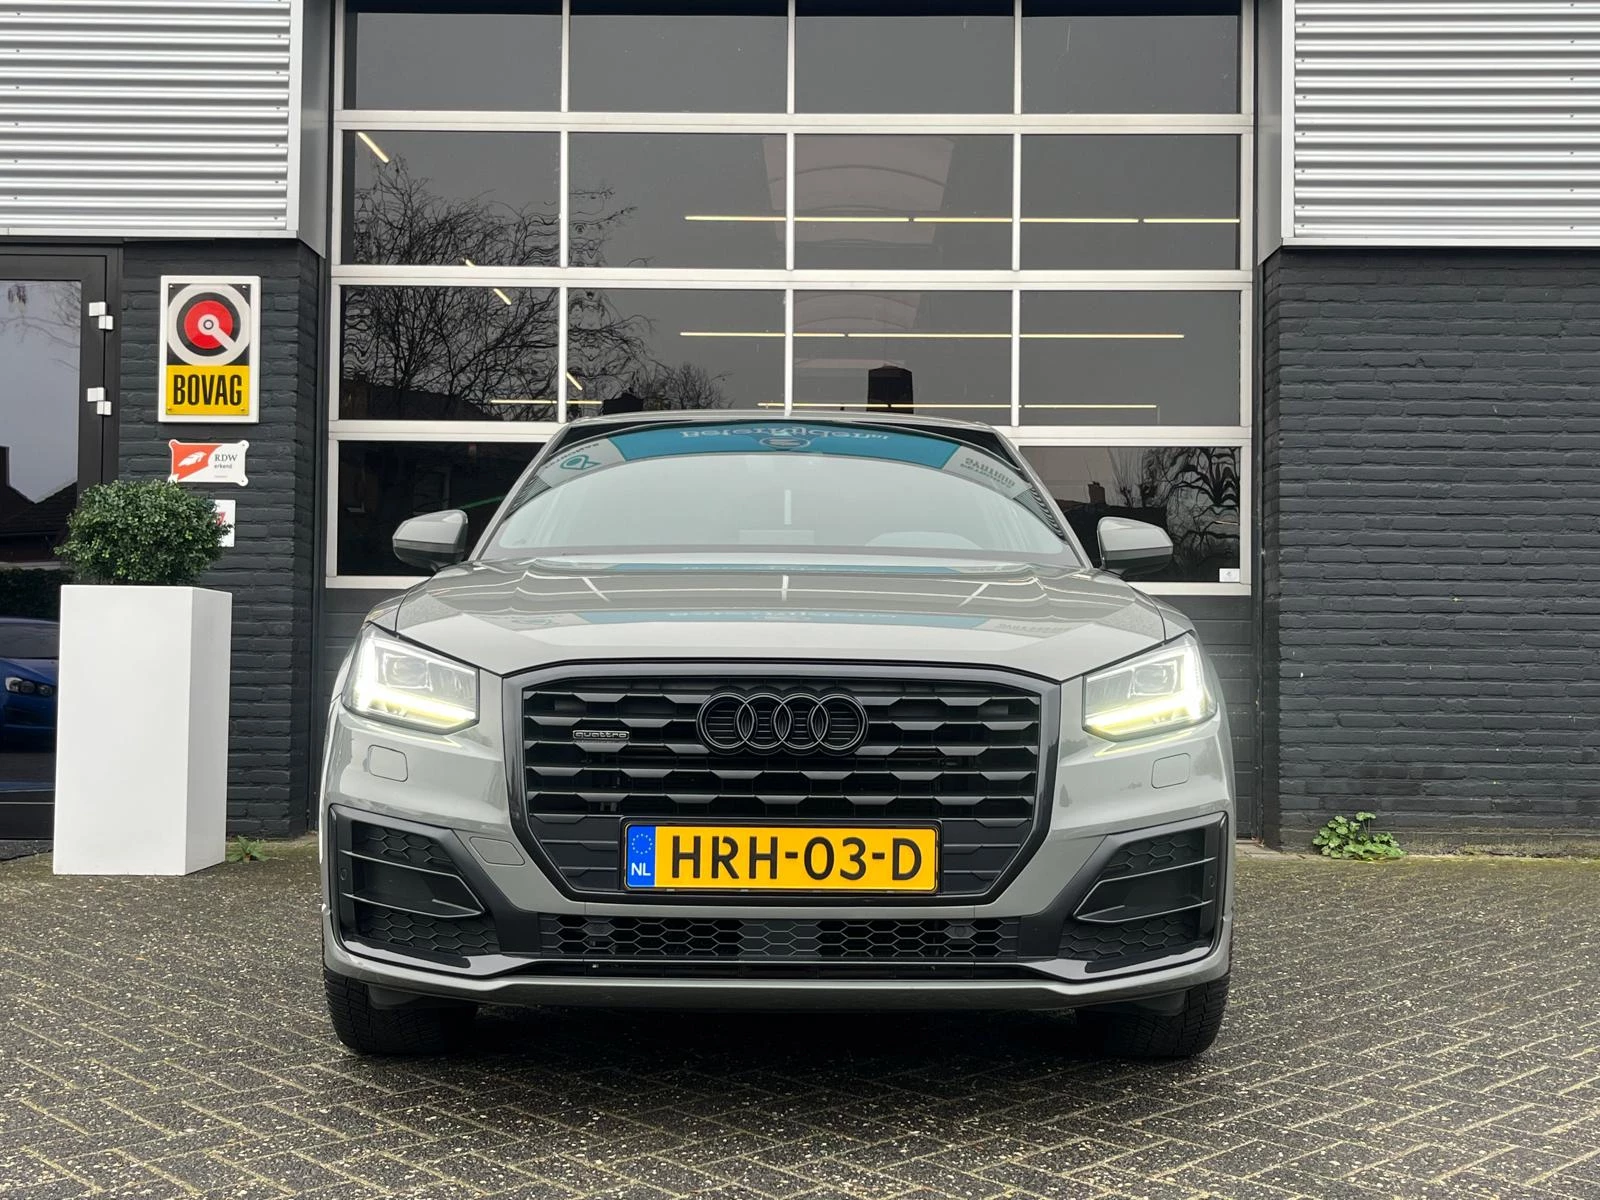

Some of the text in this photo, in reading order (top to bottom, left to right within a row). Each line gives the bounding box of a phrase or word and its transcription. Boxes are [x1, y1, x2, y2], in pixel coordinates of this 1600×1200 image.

[173, 374, 242, 405] BOVAG
[214, 454, 238, 462] RDW
[574, 731, 628, 740] quattro
[671, 835, 922, 881] HRH-03-D
[631, 862, 651, 876] NL
